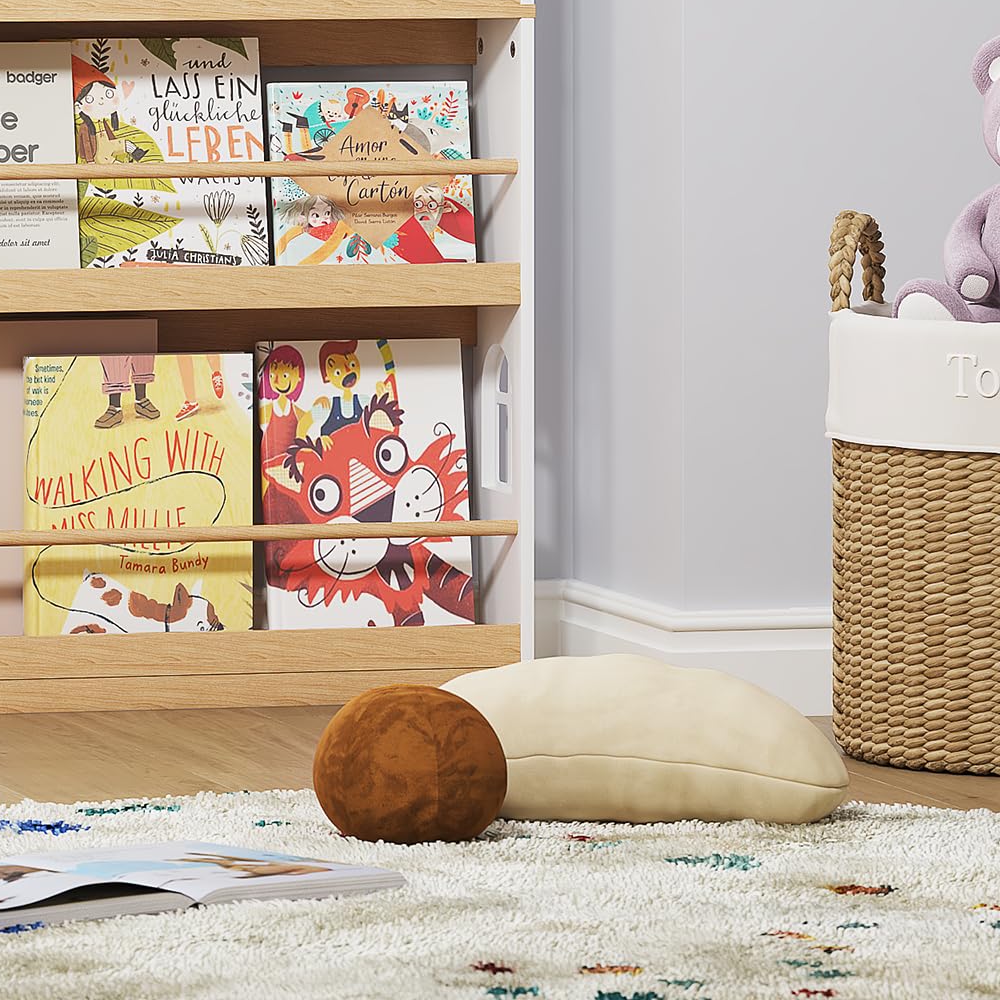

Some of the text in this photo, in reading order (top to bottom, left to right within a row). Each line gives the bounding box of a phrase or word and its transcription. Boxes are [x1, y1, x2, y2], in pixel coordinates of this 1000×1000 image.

[182, 52, 232, 70] und
[7, 71, 58, 85] badger
[151, 72, 201, 100] LASS
[148, 98, 262, 132] glückliche
[167, 125, 265, 162] LEBEN
[338, 134, 388, 157] Amor
[346, 179, 413, 207] Cartón
[20, 238, 30, 247] sit
[32, 238, 51, 247] amet
[946, 354, 1000, 399] To
[35, 429, 225, 506] WALKING WITH
[119, 552, 209, 575] Tamara Bundy
